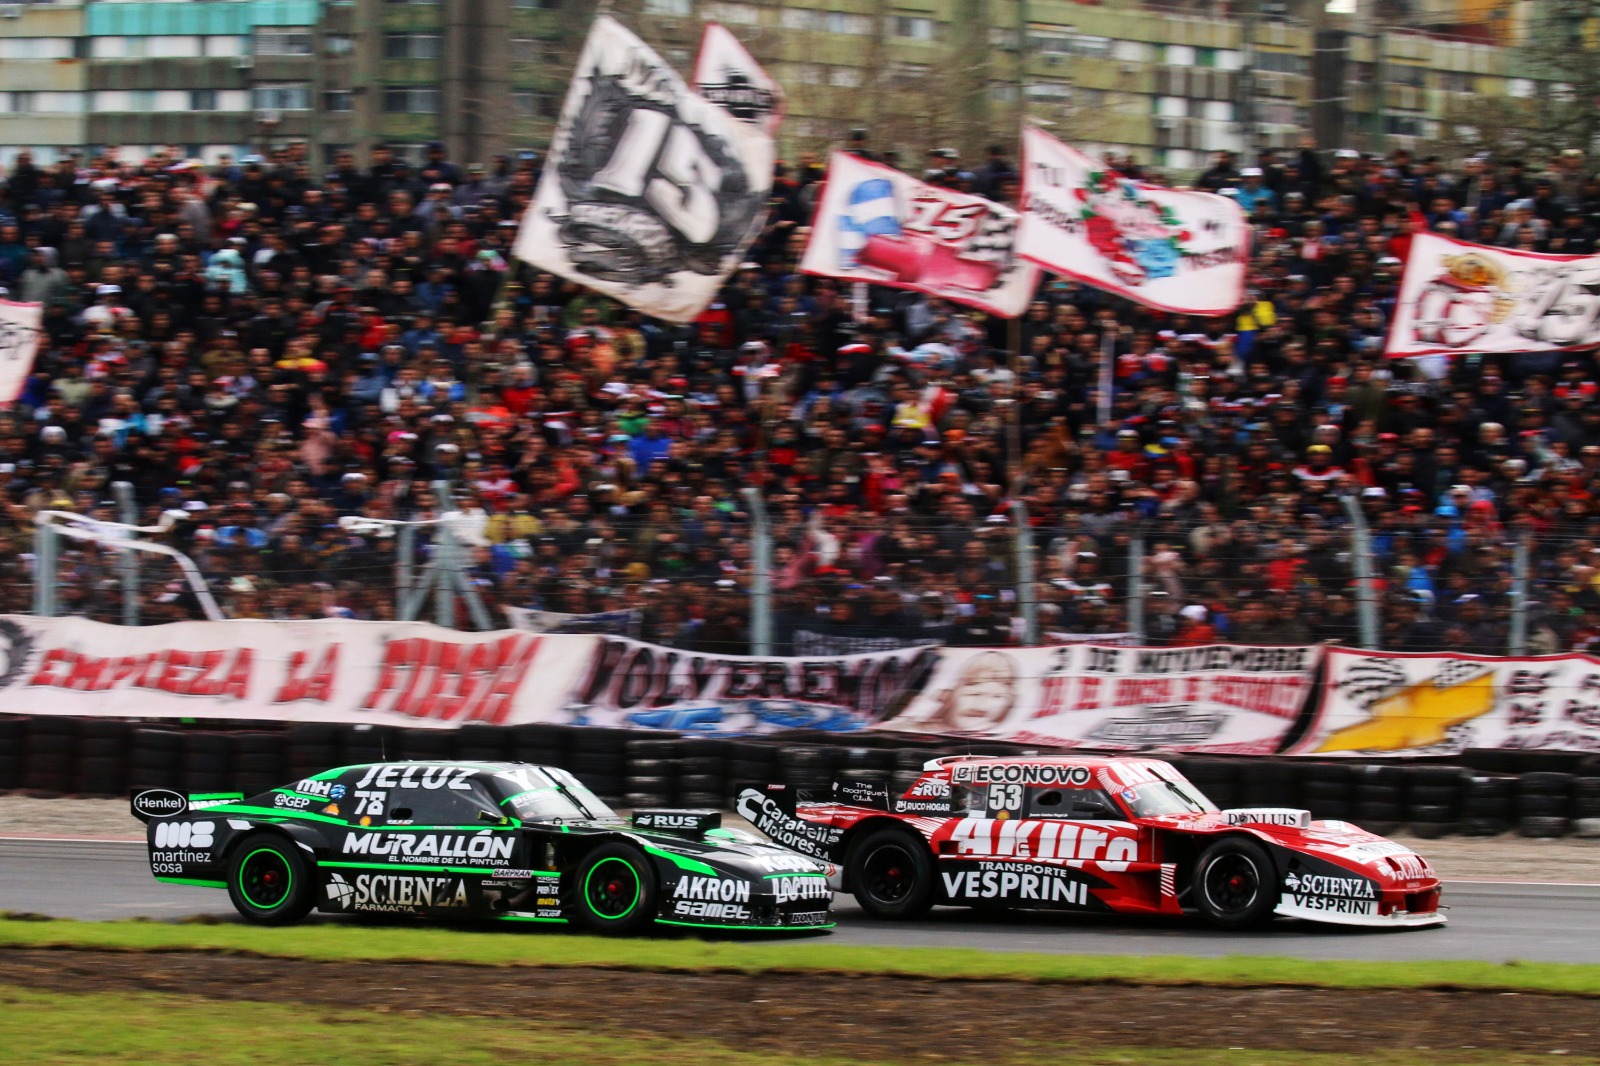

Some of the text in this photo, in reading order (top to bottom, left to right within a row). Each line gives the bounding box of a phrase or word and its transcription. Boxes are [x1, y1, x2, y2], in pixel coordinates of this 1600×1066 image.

[356, 765, 480, 790] JELUZ
[976, 765, 1089, 783] ECONOVO
[923, 785, 950, 796] RUS
[989, 784, 1022, 811] 53
[138, 798, 182, 809] Henkel
[354, 790, 387, 815] 78
[926, 803, 950, 812] HOGAR
[654, 815, 698, 827] RUS
[1262, 813, 1296, 826] LUIS
[758, 814, 815, 853] Motores
[342, 829, 515, 859] MURALLÓN
[152, 850, 211, 863] martínez
[470, 858, 509, 866] PINTURA
[152, 863, 183, 873] sosa
[979, 861, 1067, 878] TRANSPORTE
[355, 873, 470, 908] SCIENZA
[673, 875, 750, 903] AKRON
[942, 871, 1088, 905] VESPRINI
[1300, 874, 1375, 898] SCIENZA
[674, 900, 750, 919] samet
[1294, 893, 1372, 915] VESPRINI
